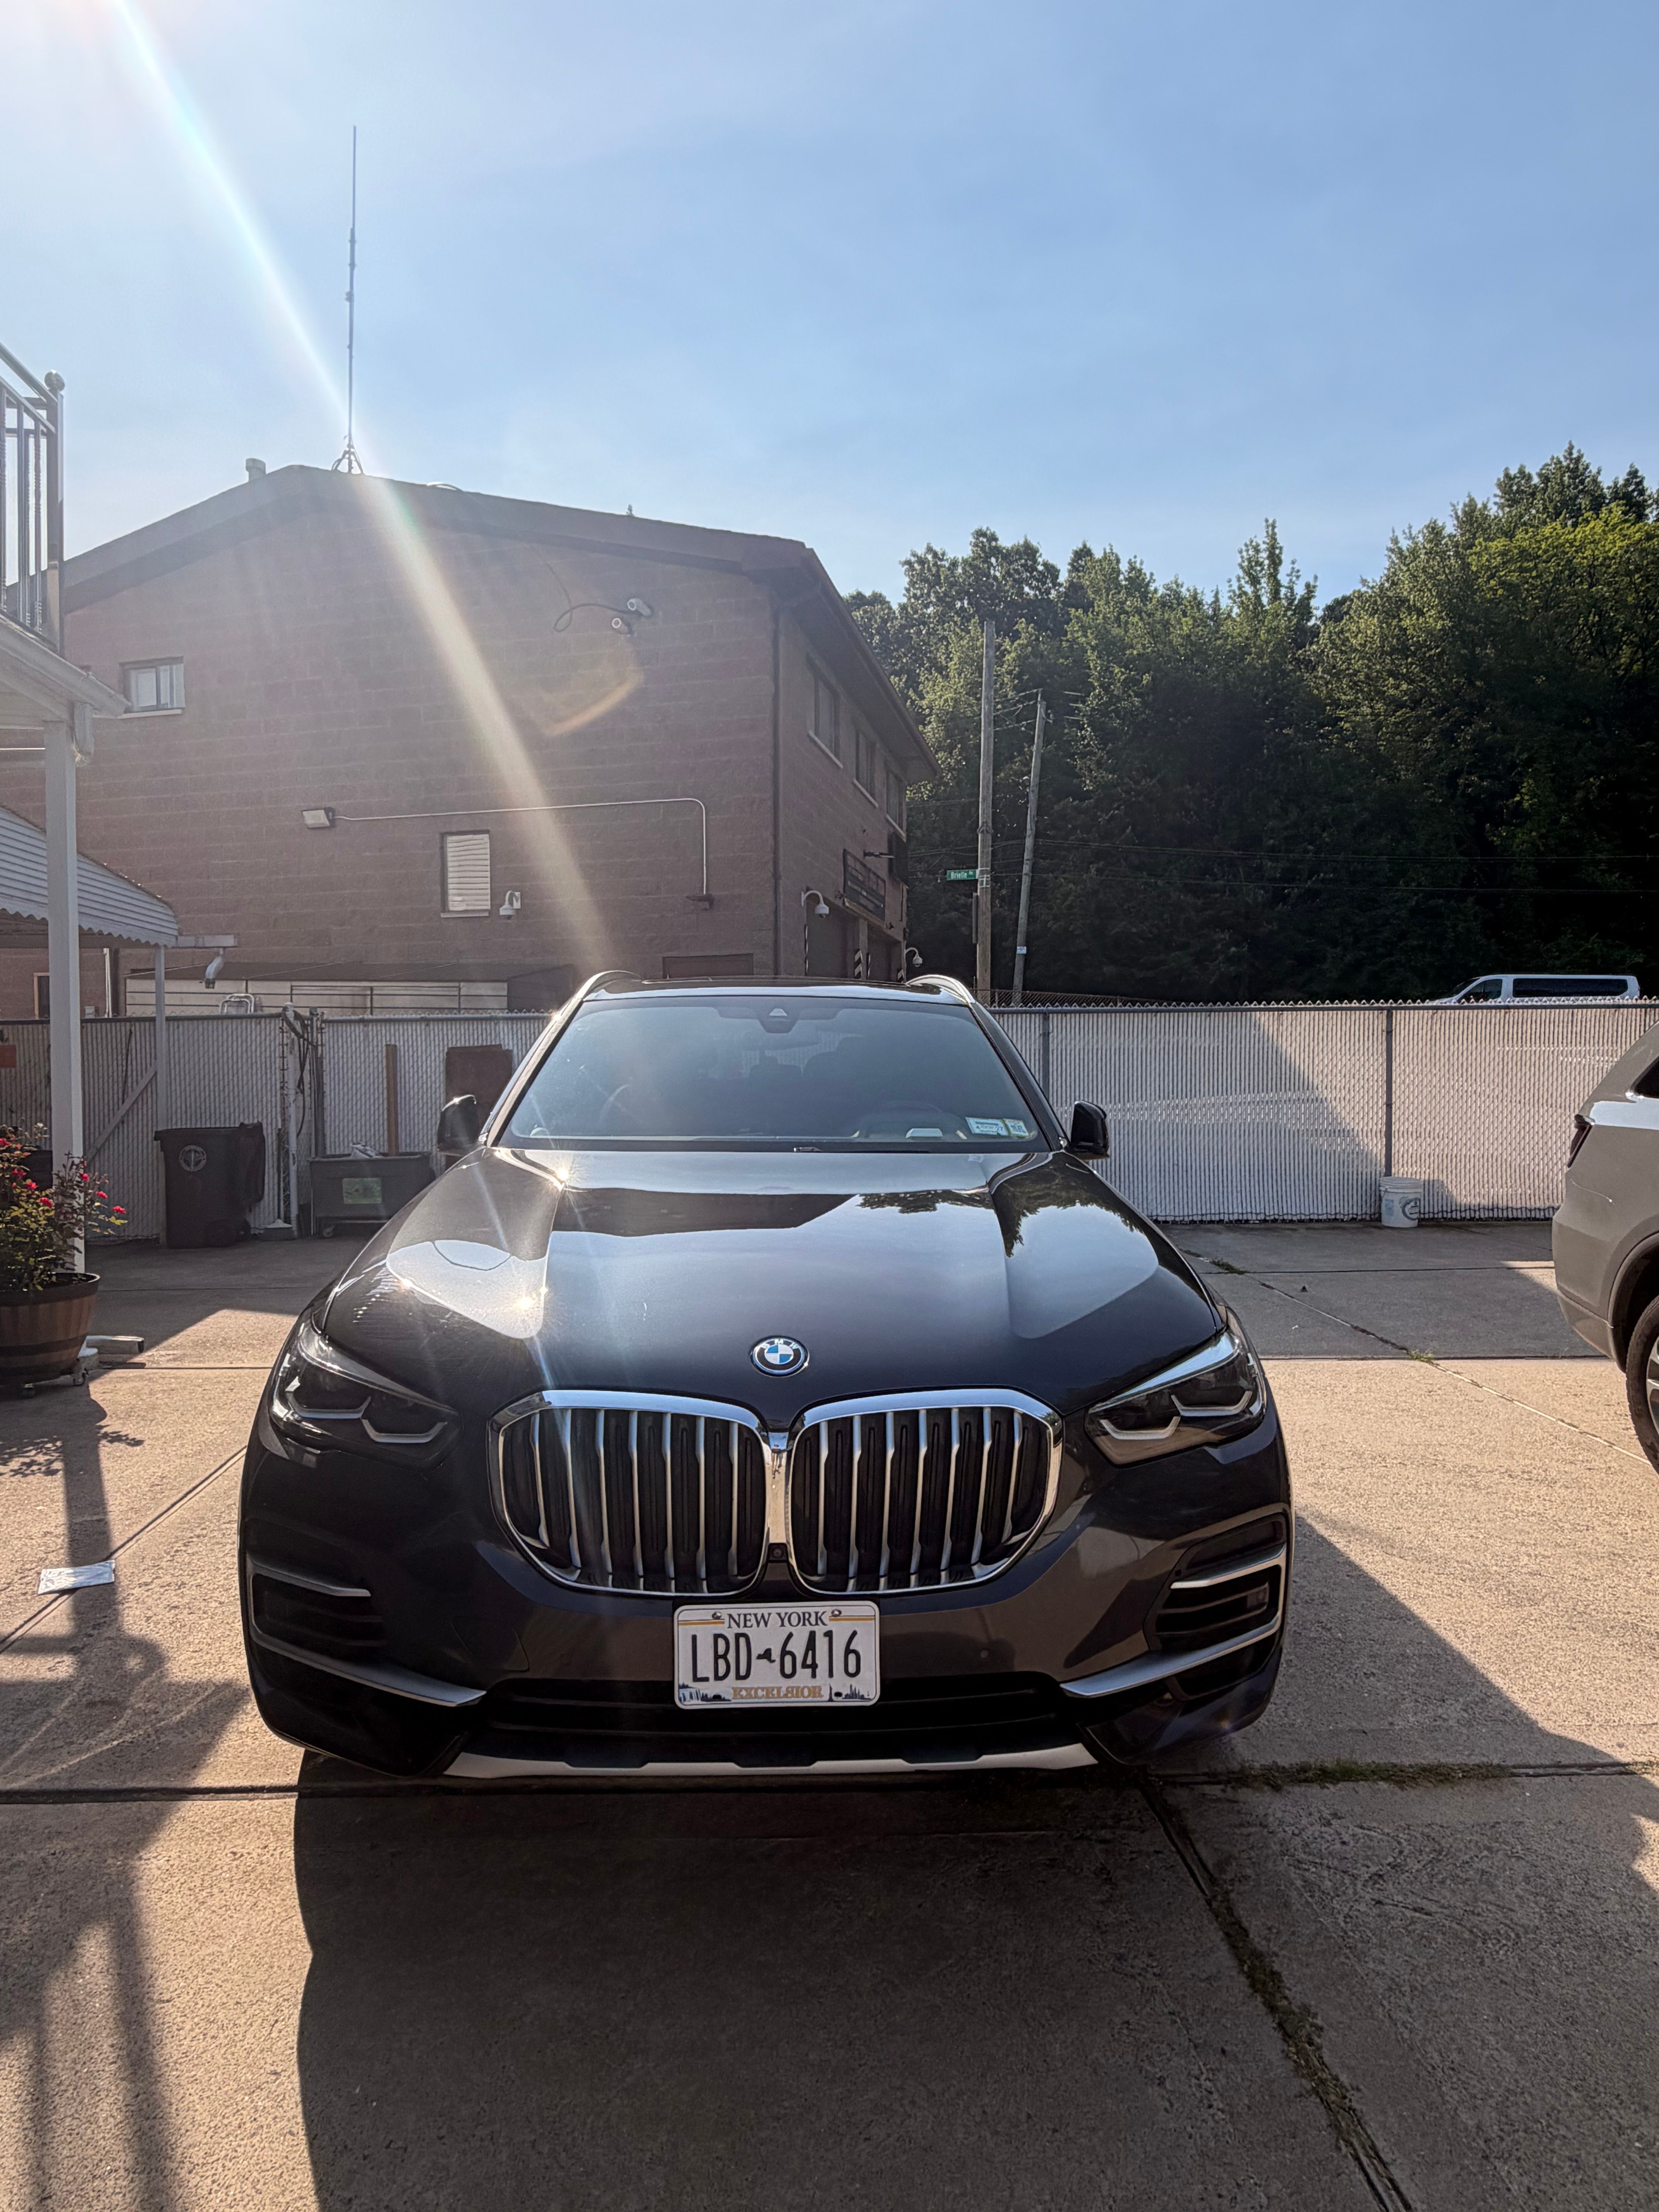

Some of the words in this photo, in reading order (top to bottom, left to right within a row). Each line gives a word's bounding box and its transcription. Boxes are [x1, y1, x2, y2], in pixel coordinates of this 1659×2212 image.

[950, 871, 967, 879] Brielle
[758, 1338, 800, 1349] BMW
[727, 1613, 772, 1629] NEW
[776, 1611, 828, 1627] YORK
[732, 1685, 824, 1700] EXCELSIOR
